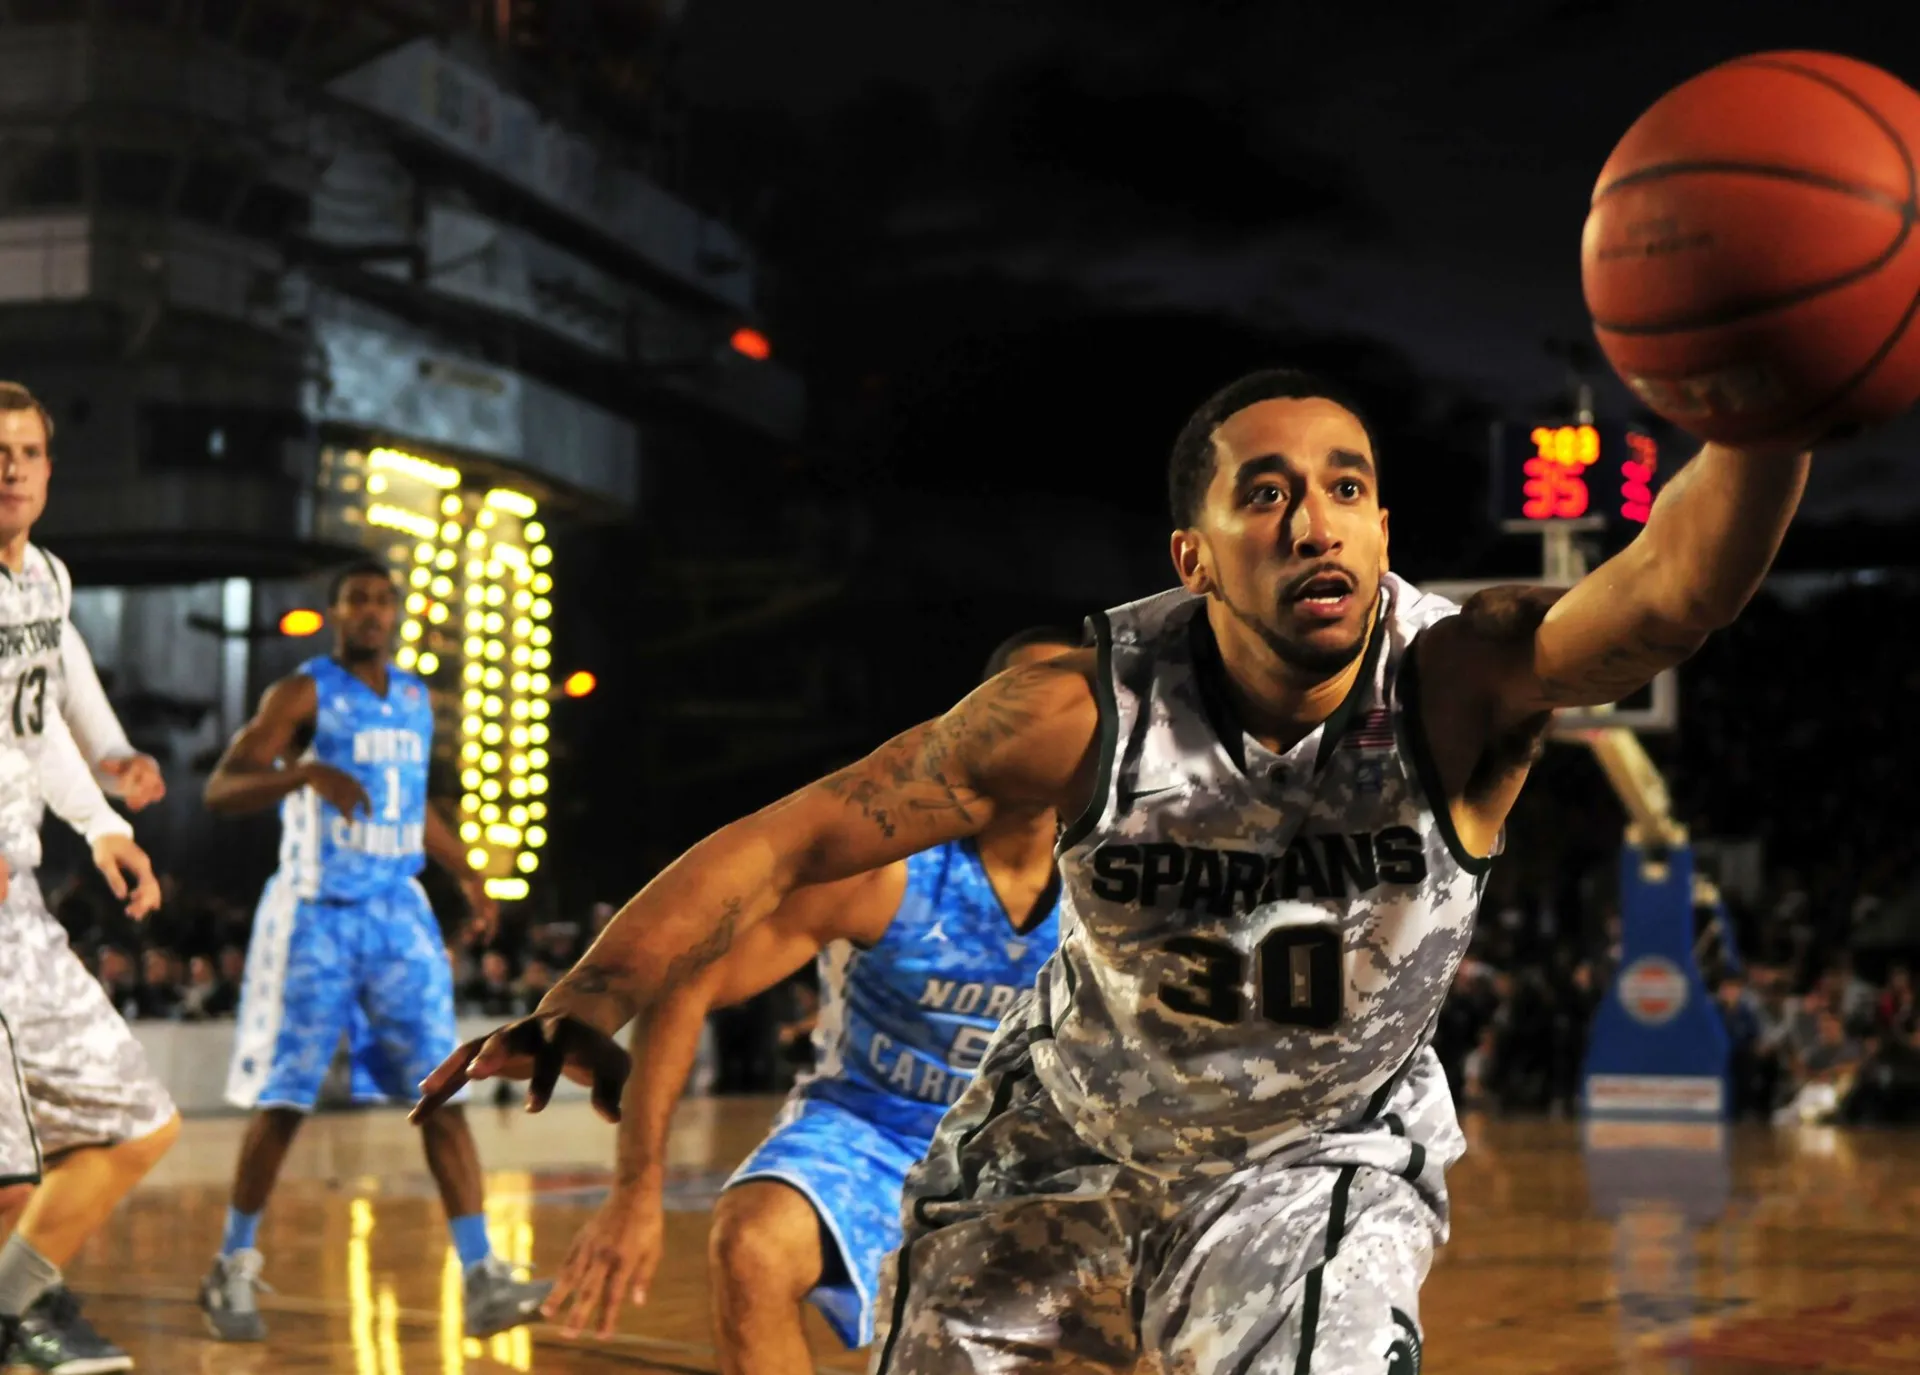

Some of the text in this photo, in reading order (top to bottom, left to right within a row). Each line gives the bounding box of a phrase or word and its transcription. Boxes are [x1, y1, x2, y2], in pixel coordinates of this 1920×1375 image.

[12, 665, 47, 736] 13
[384, 766, 401, 821] 1
[918, 978, 1036, 1019] NOR
[1157, 924, 1344, 1029] 30
[948, 1026, 995, 1076] 5
